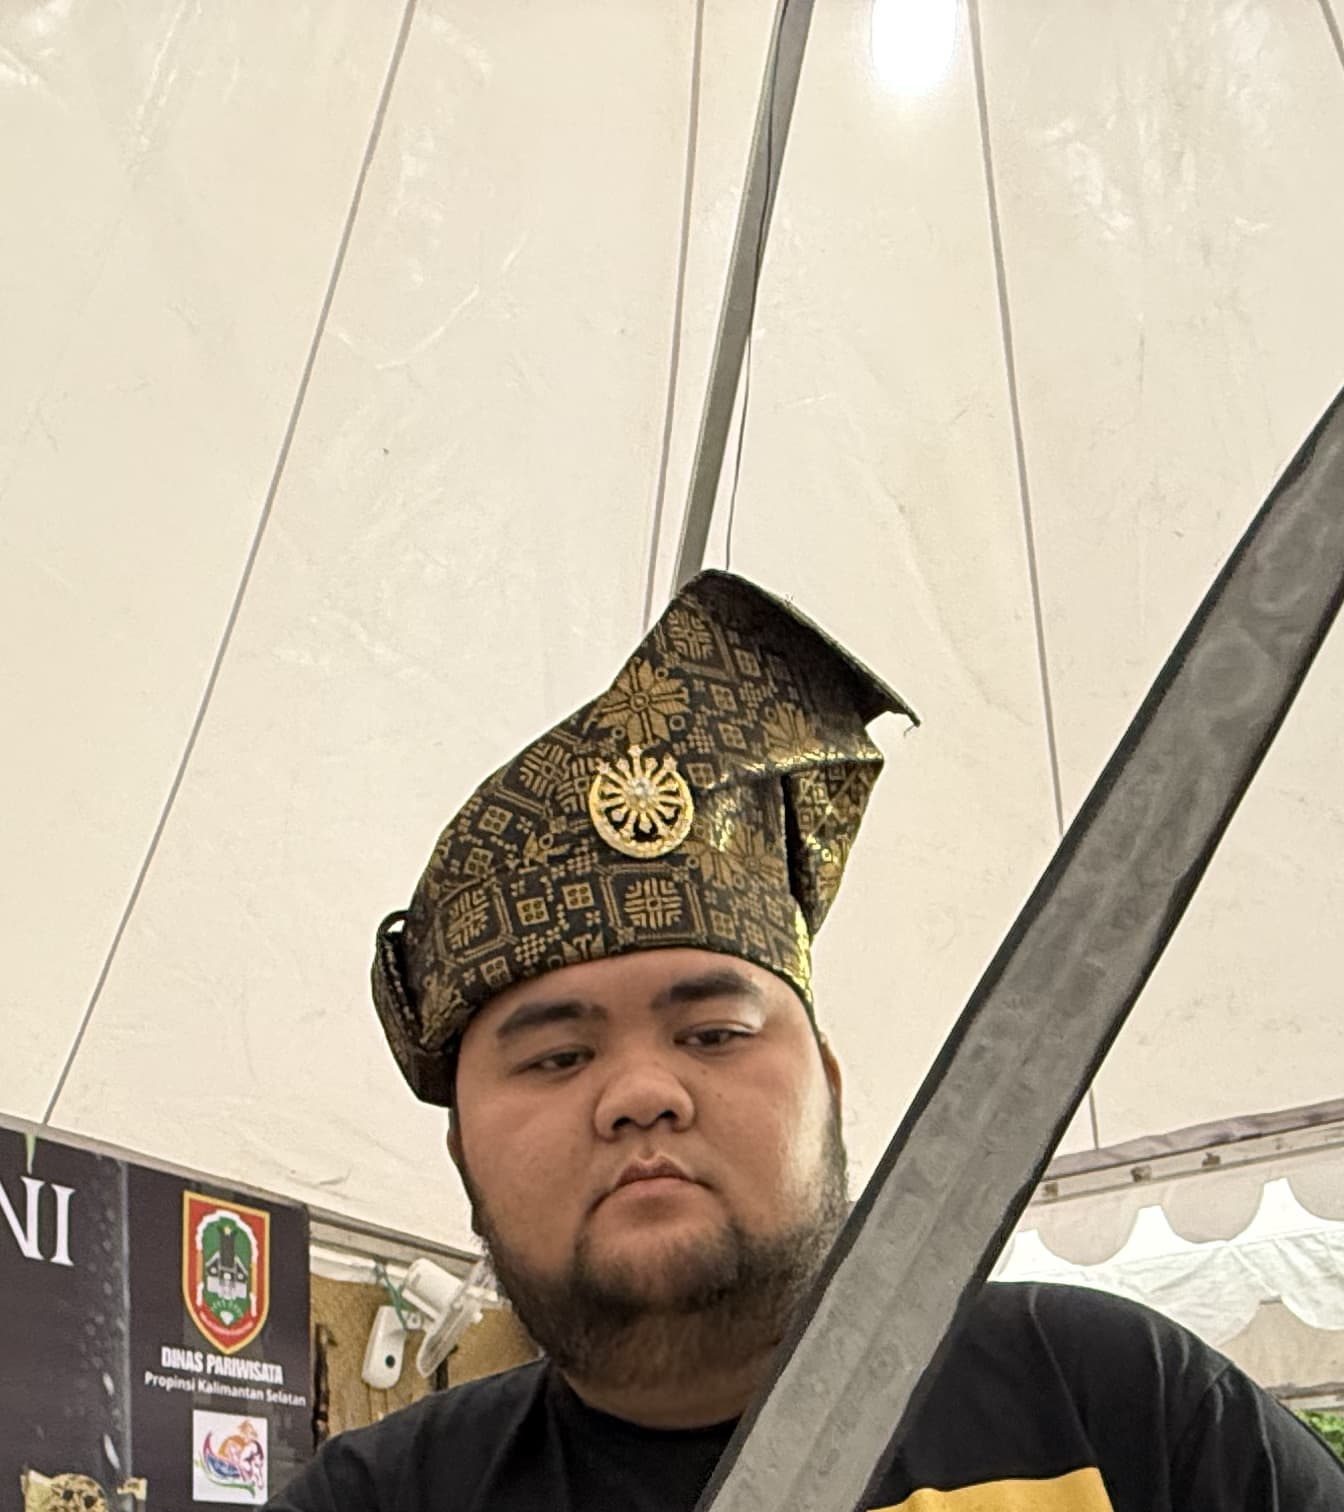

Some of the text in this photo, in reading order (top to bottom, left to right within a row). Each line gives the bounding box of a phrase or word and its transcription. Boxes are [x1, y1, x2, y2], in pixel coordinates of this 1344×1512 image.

[161, 1347, 283, 1384] DINAS PARIWISATA
[145, 1372, 306, 1406] Propinsi Kalimantan Selatan
